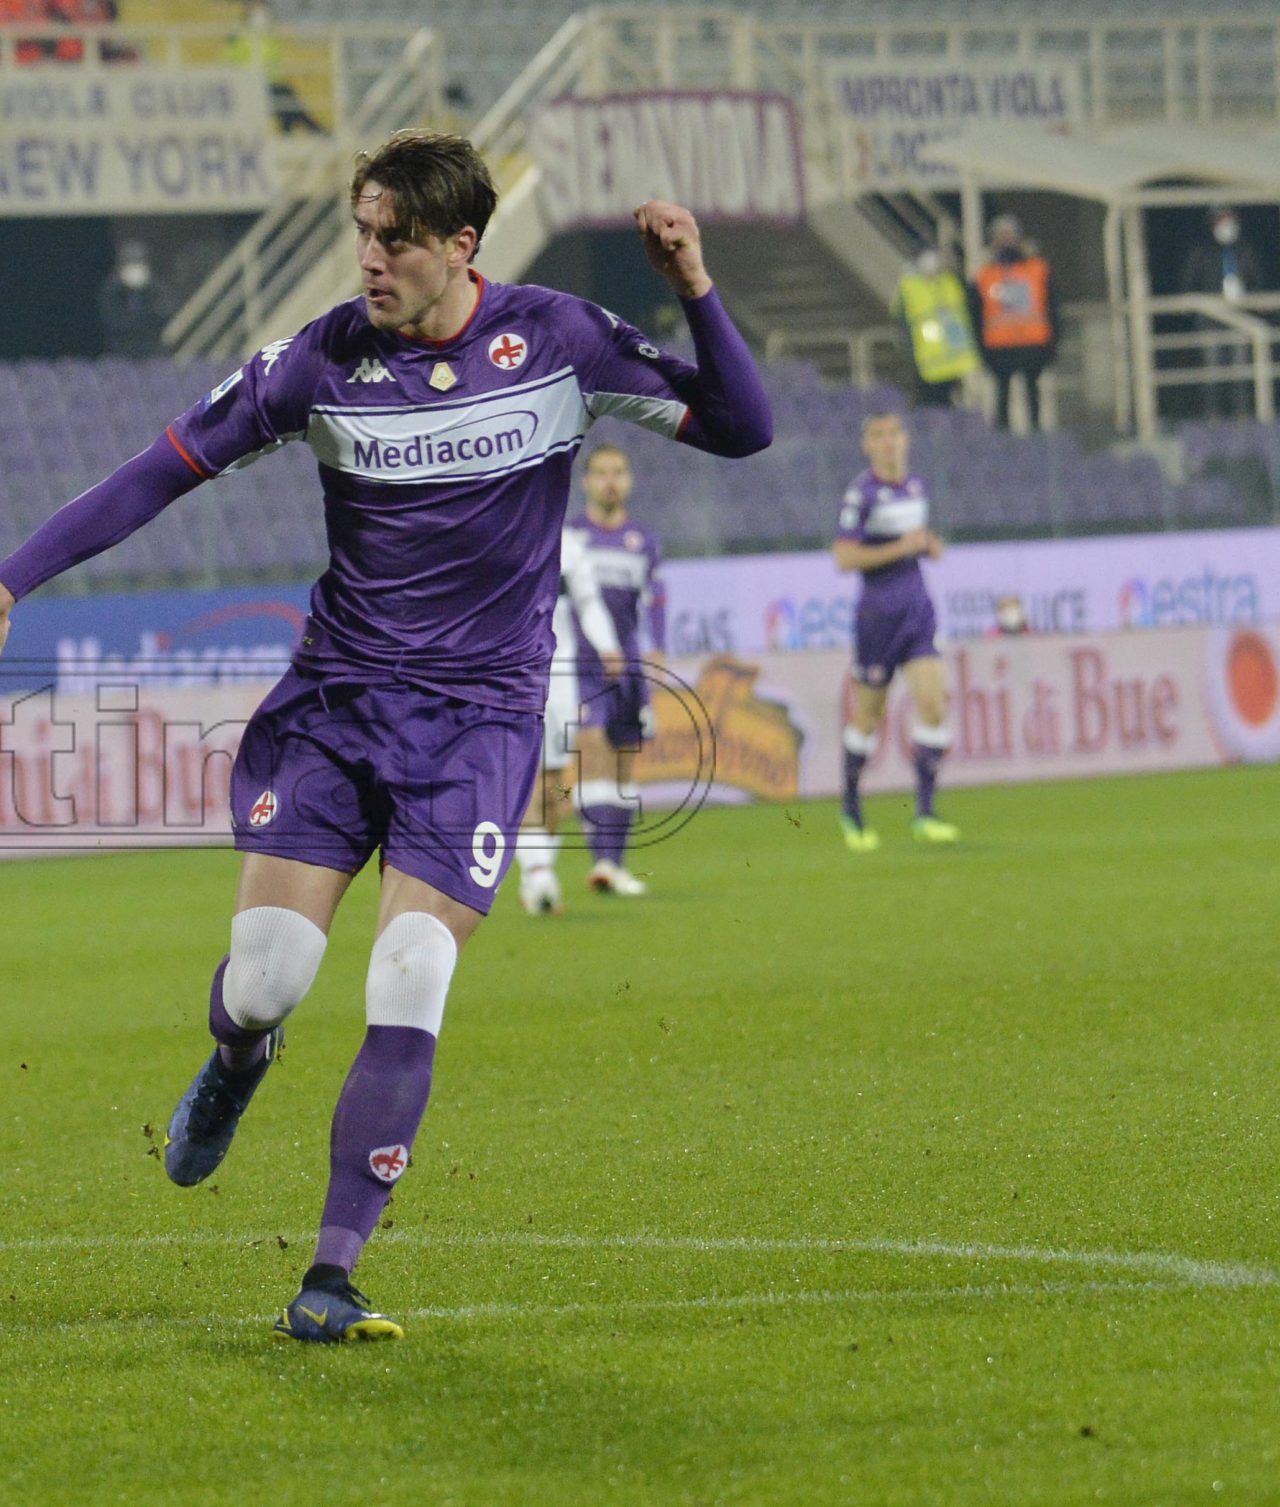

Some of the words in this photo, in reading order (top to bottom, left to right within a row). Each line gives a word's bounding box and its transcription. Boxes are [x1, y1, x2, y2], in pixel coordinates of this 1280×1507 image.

[116, 132, 274, 197] YORK
[353, 424, 525, 470] Mediacom
[1070, 645, 1181, 754] Bue
[128, 706, 236, 826] Bu
[470, 821, 506, 888] 9
